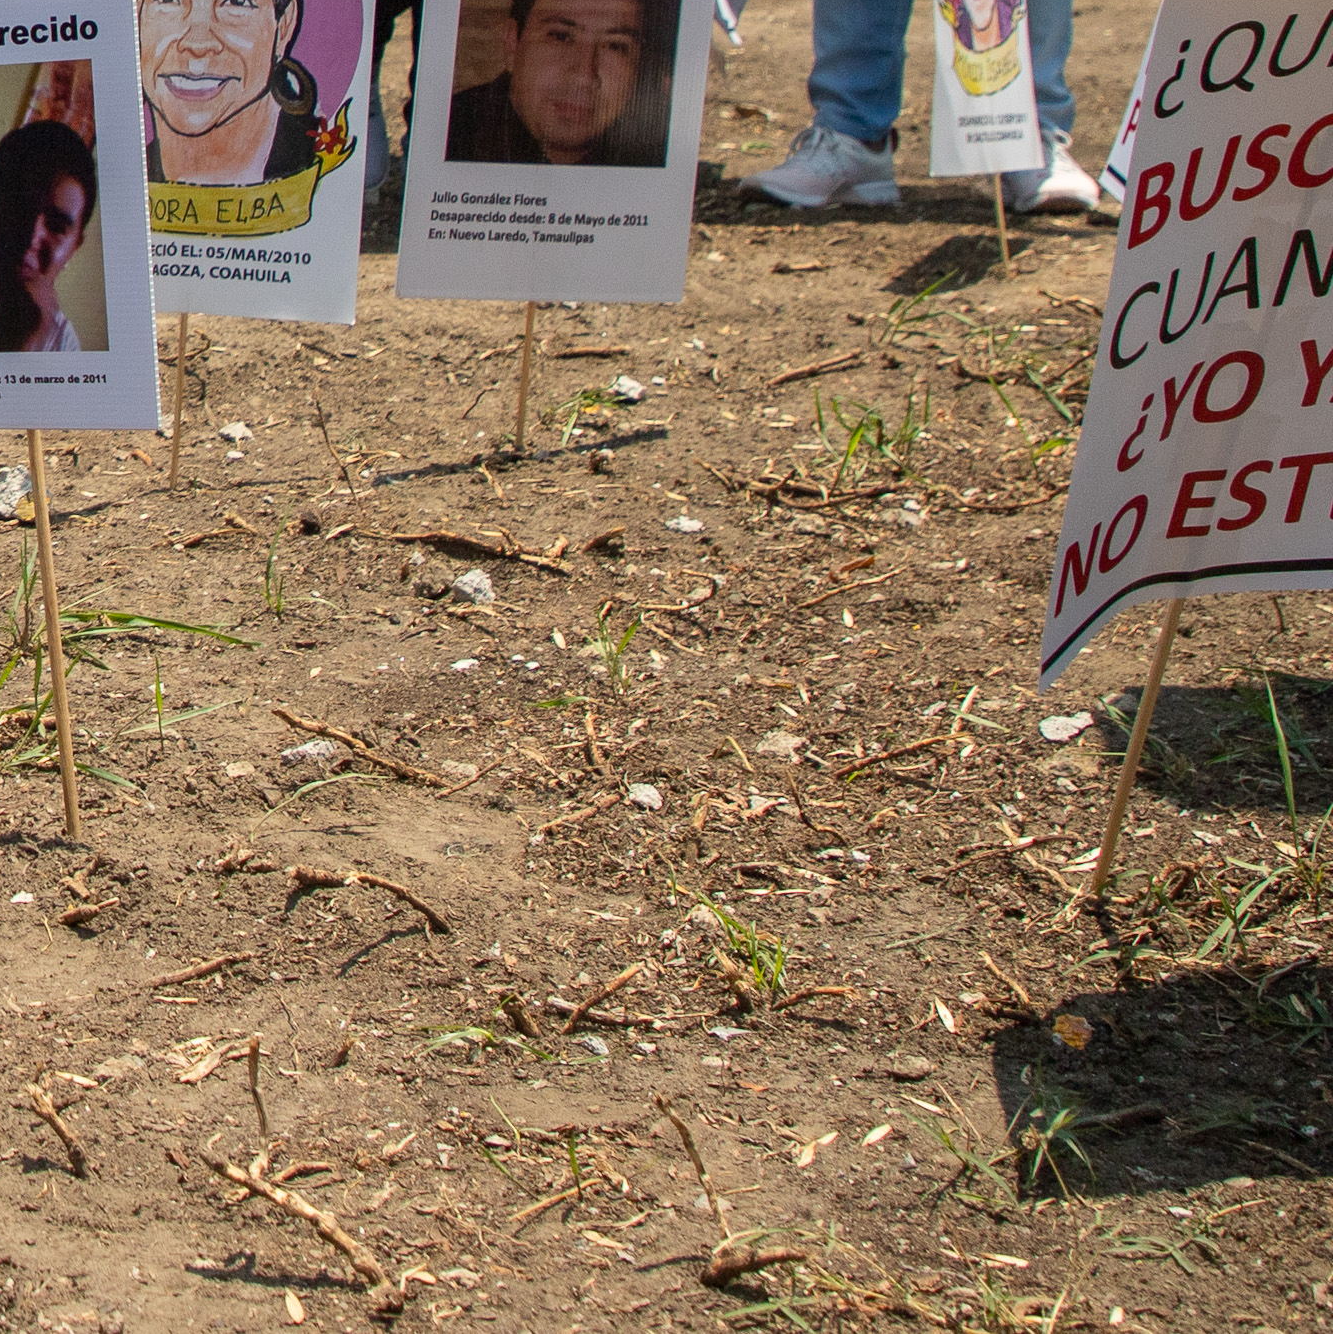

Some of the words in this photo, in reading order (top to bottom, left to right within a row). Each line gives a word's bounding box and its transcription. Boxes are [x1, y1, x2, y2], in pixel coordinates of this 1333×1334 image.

[1153, 9, 1333, 119] ¿QU
[1127, 112, 1333, 250] BUSC
[216, 191, 286, 225] ELBA
[431, 191, 458, 204] Julio
[460, 192, 512, 205] González
[514, 194, 548, 207] Flores
[430, 210, 506, 225] Desaparecido
[509, 212, 545, 225] desde:
[548, 213, 555, 225] 8
[558, 213, 572, 225] de
[574, 214, 605, 228] Mayo
[607, 214, 621, 226] de
[622, 215, 649, 227] 2011
[428, 228, 446, 240] En:
[449, 229, 485, 241] Nuevo
[488, 230, 530, 243] Laredo,
[532, 231, 595, 246] Tamaulipas
[180, 244, 202, 258] EL:
[206, 247, 312, 265] 05/MAR/2010
[153, 263, 206, 279] AGOZA,
[209, 266, 292, 283] COAHUILA
[1109, 228, 1333, 370] CUAN
[4, 375, 16, 384] 13
[19, 374, 32, 384] de
[34, 376, 65, 384] marzo
[68, 374, 80, 384] de
[82, 374, 107, 384] 2011
[1116, 349, 1266, 473] ¿YO
[1299, 339, 1333, 408] Y
[1053, 493, 1149, 619] NO
[1165, 451, 1333, 540] EST
